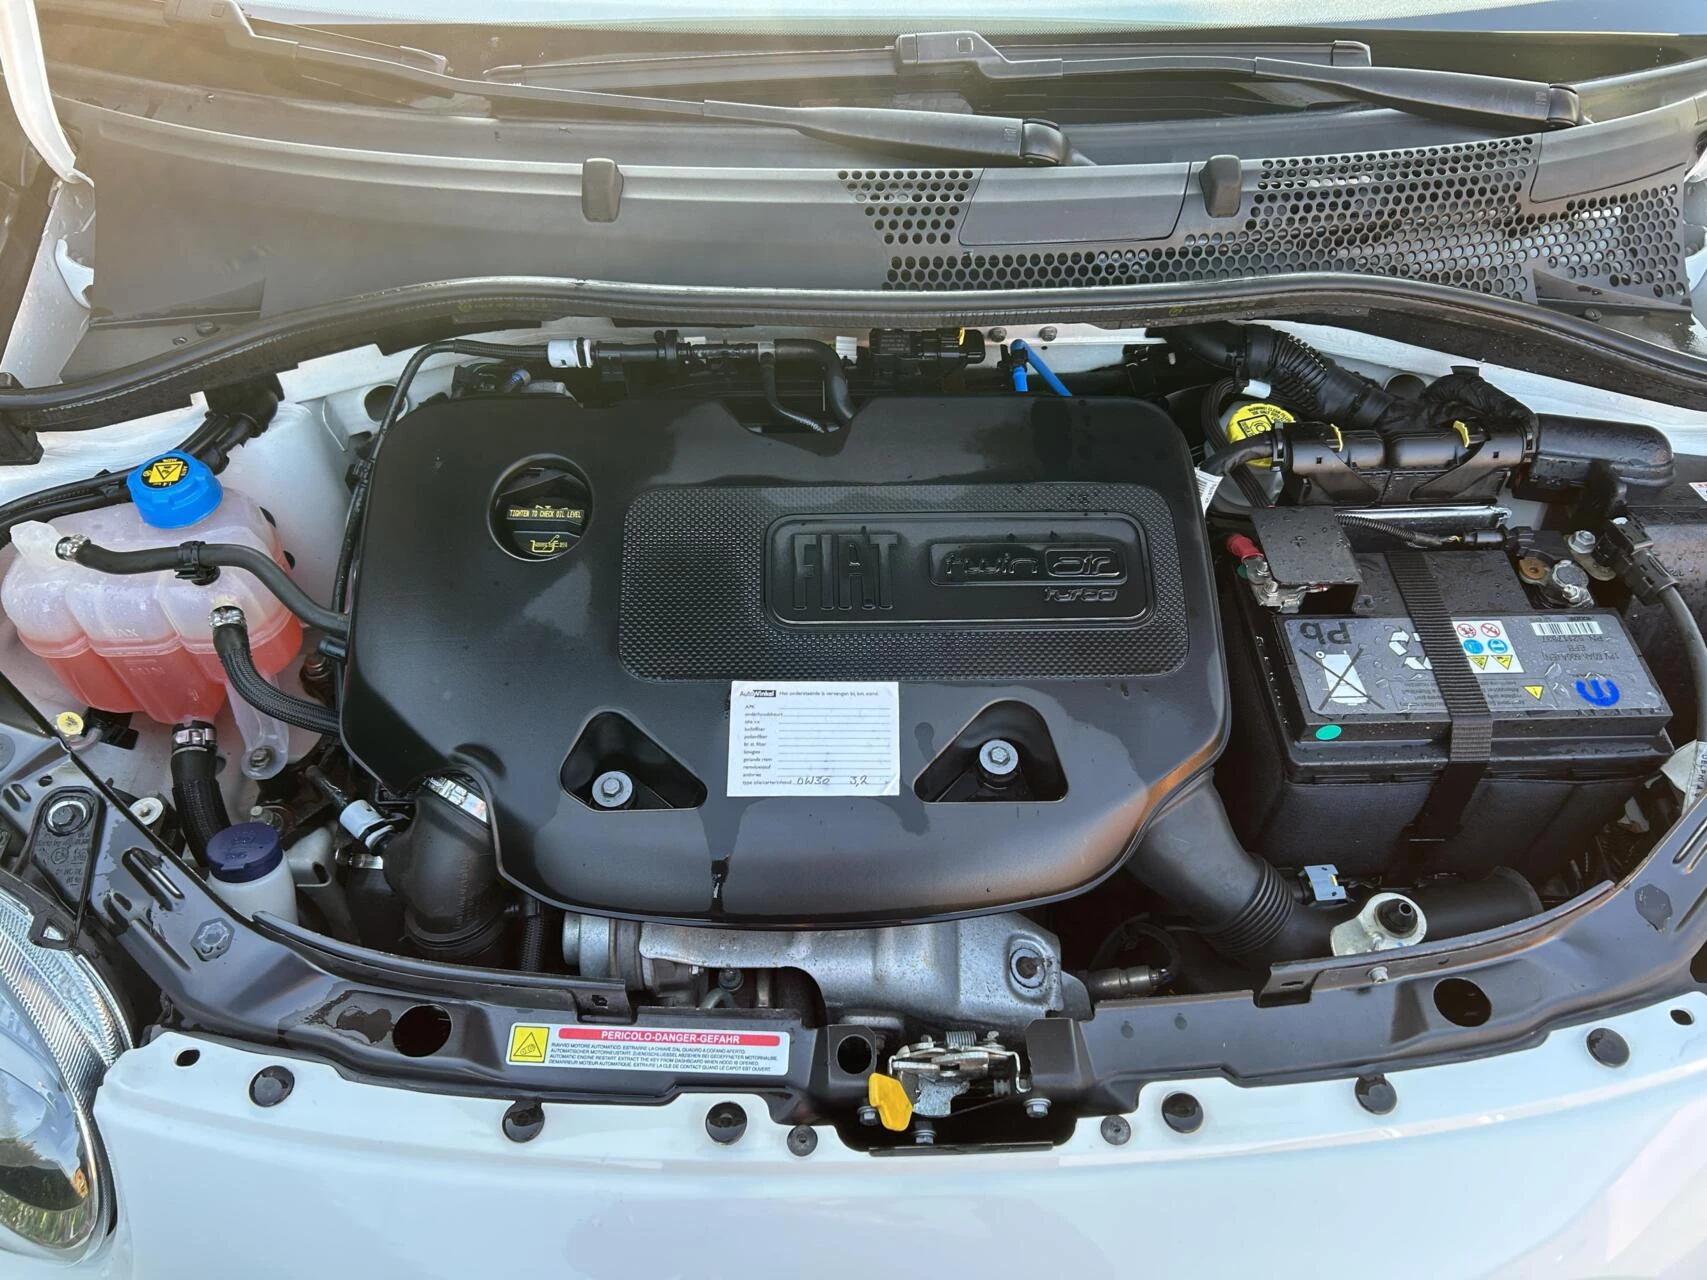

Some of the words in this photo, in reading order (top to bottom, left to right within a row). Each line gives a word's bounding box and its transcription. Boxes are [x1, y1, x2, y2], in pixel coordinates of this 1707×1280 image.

[510, 510, 530, 518] TIGHTEN
[792, 533, 898, 611] FIAT
[1044, 587, 1119, 603] turbo
[601, 1030, 740, 1044] PERICOLO-DANGER-GEFAHR
